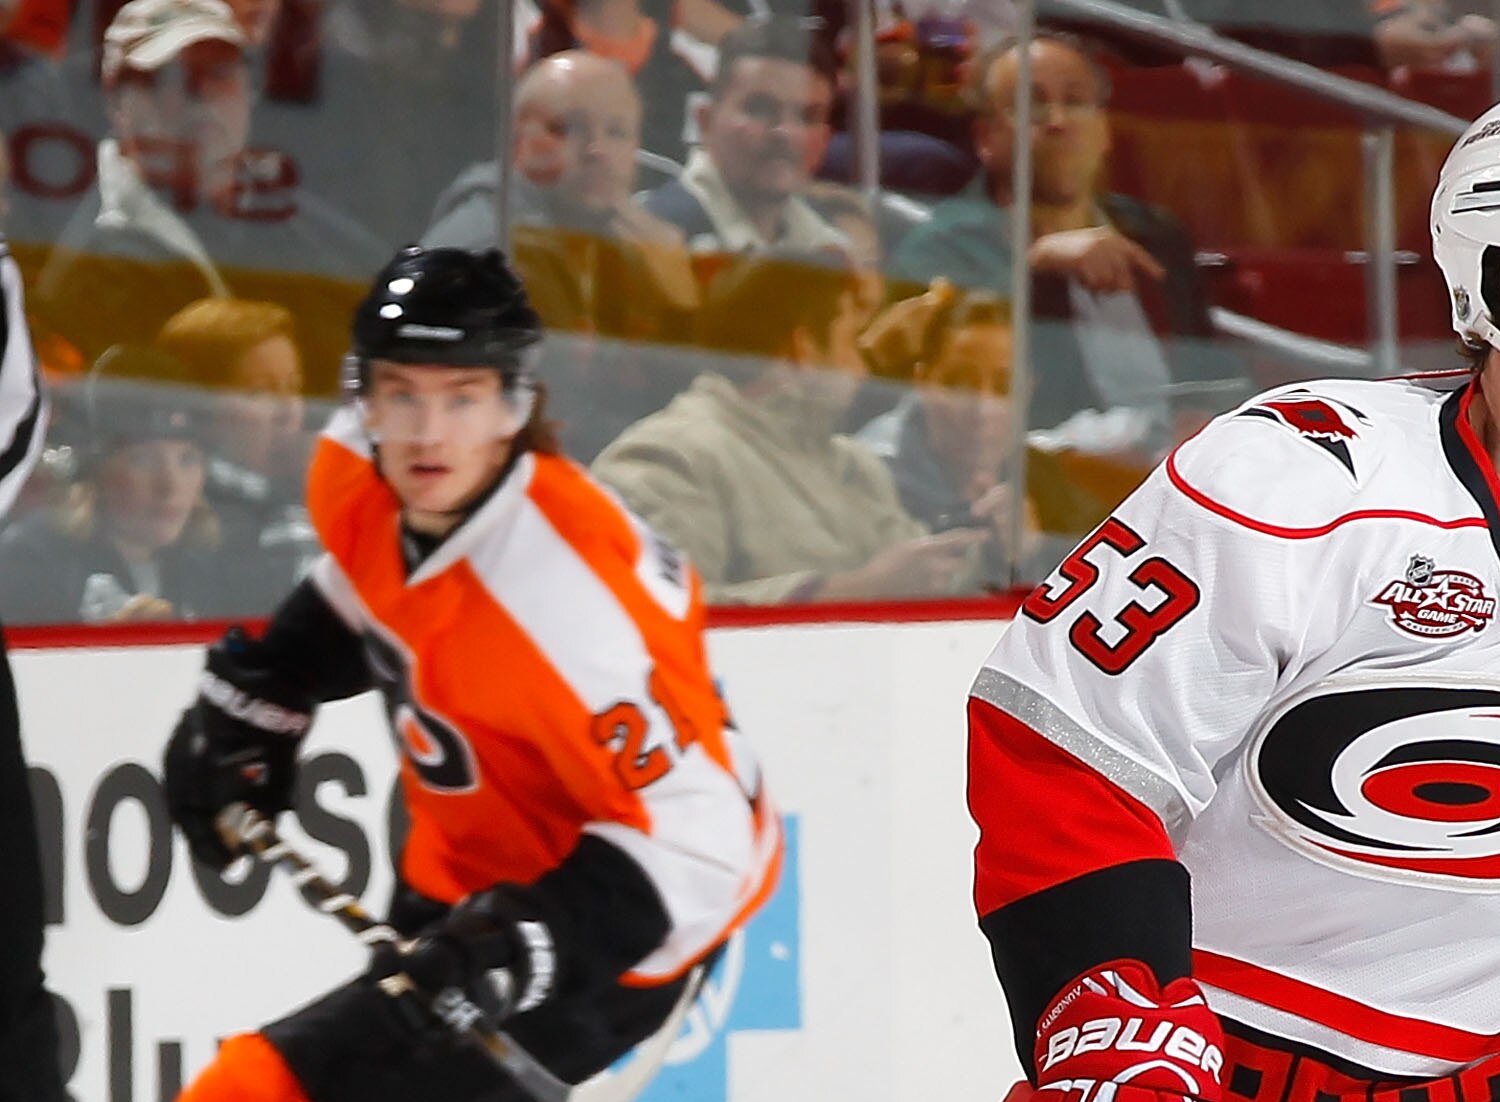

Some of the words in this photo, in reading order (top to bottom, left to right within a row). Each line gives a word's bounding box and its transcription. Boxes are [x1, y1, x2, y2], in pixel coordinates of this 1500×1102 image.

[1022, 516, 1200, 676] 53
[1379, 582, 1422, 604] ALL
[1448, 593, 1494, 615] STAR
[1417, 609, 1458, 624] GAME
[1038, 1017, 1224, 1086] BAUER
